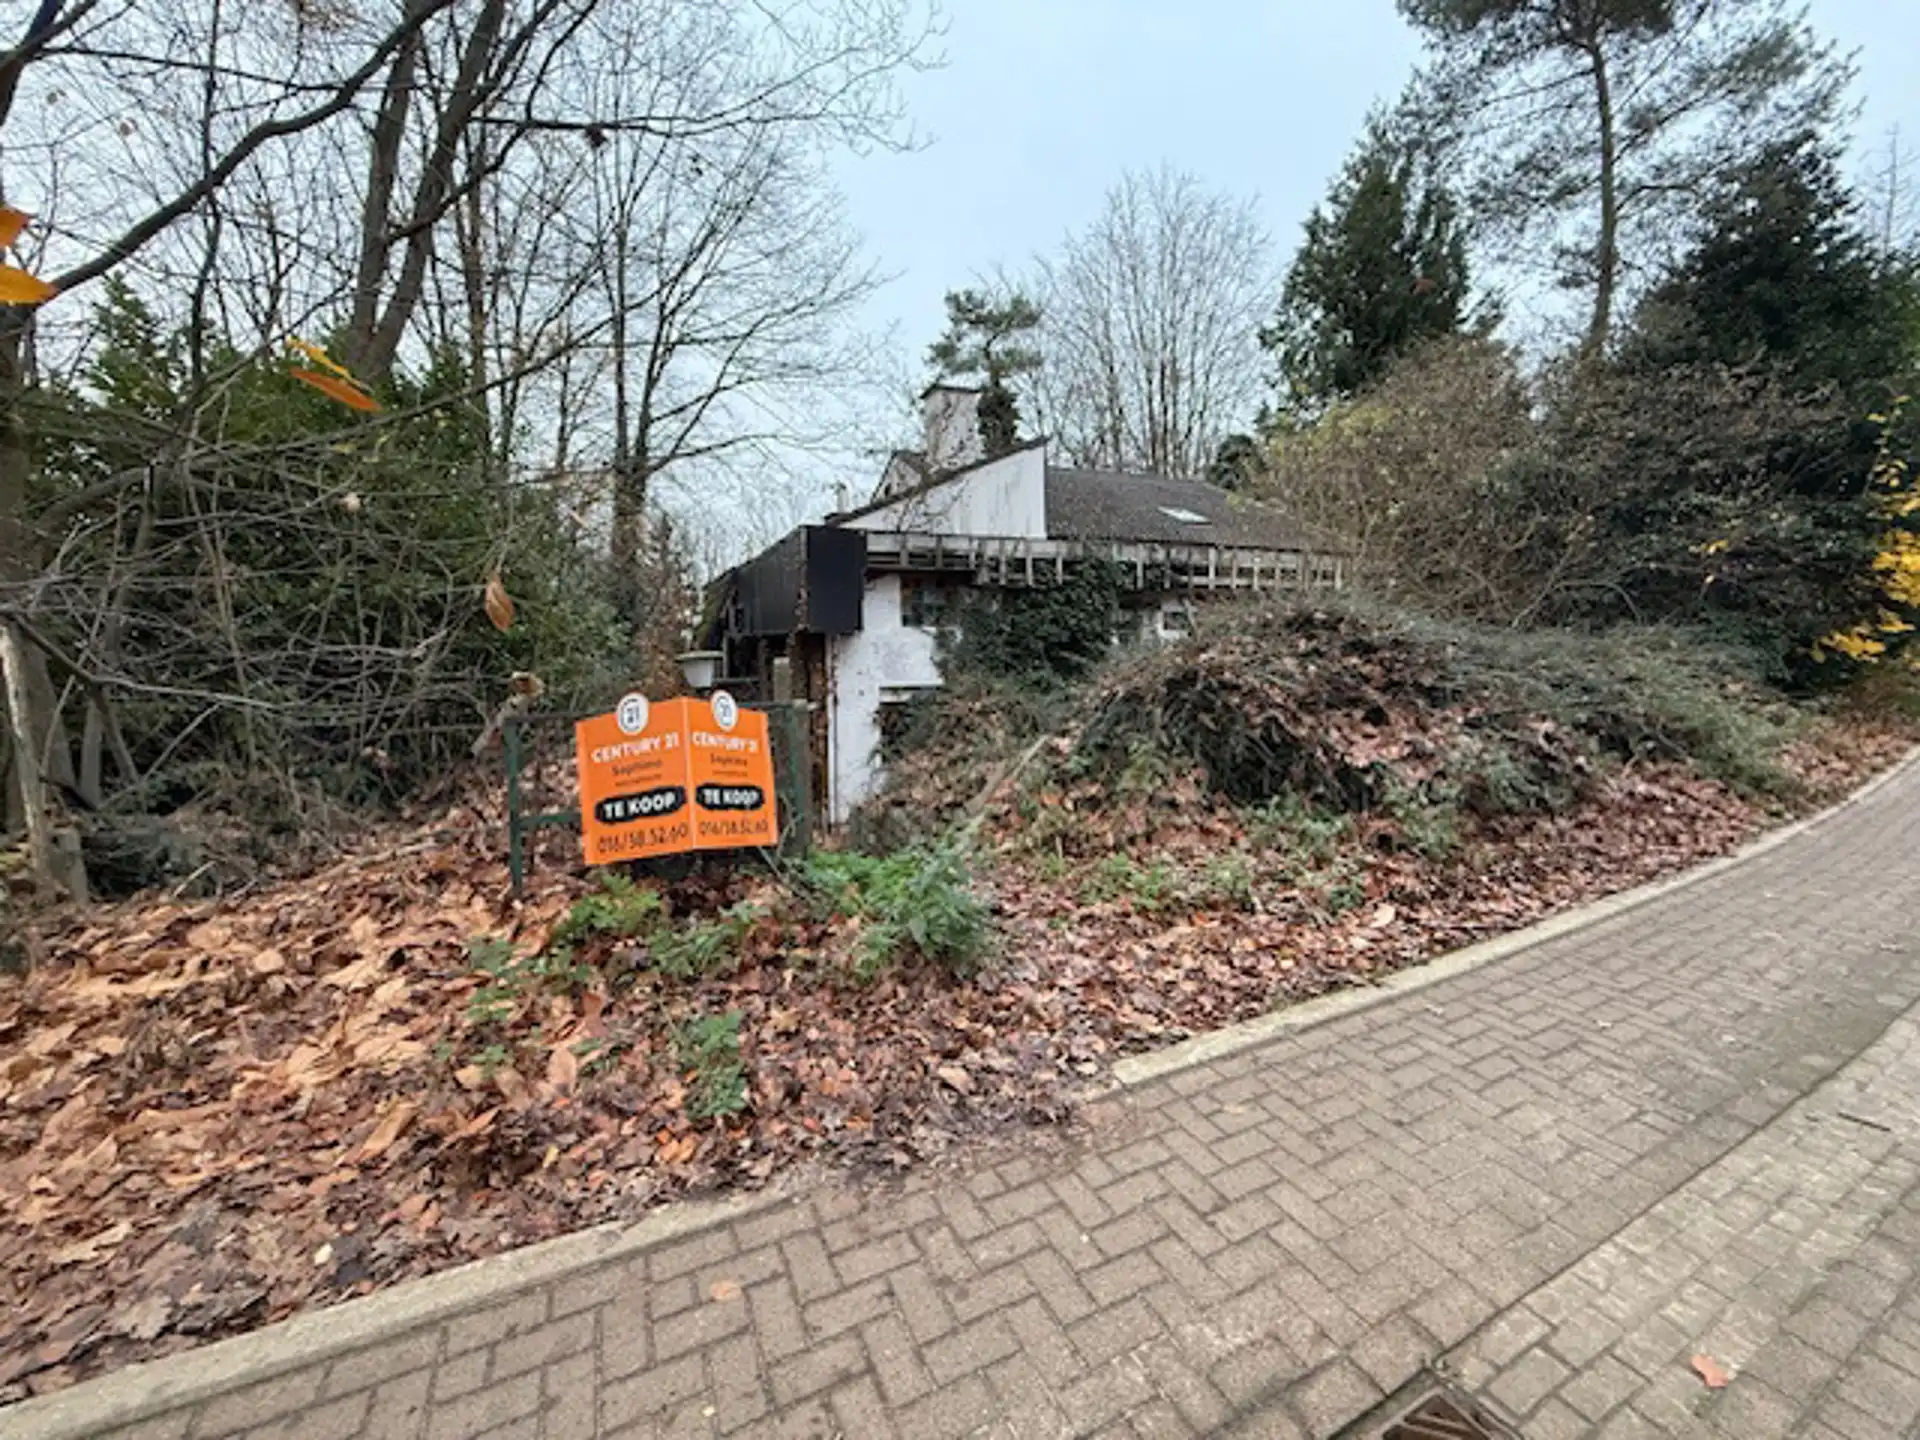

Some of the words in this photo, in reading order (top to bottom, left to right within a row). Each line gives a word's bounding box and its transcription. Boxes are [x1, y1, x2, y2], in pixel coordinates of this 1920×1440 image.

[591, 737, 660, 763] CENTURY
[692, 731, 745, 751] CENTURY
[603, 800, 625, 820] TE
[627, 791, 676, 814] KOOP
[702, 788, 721, 805] TE
[723, 789, 760, 806] KOOP
